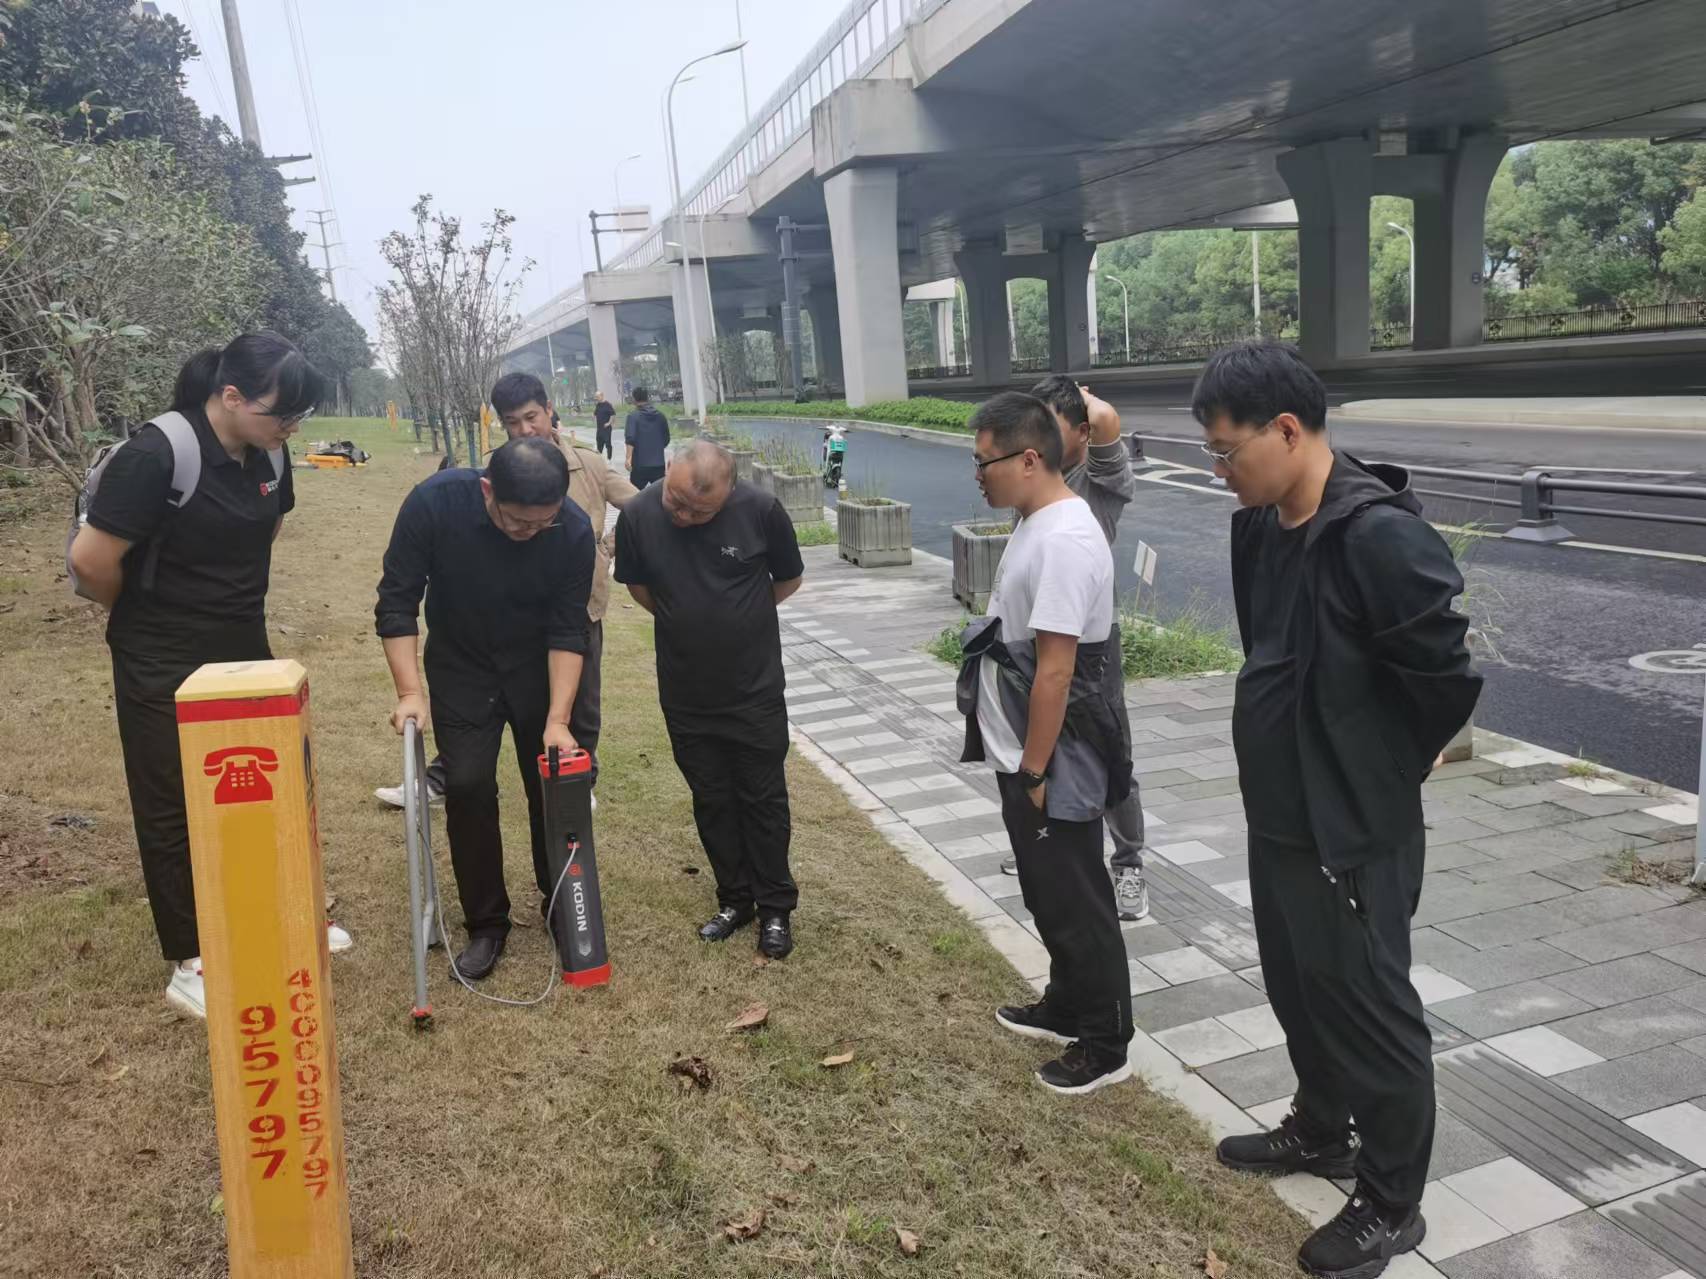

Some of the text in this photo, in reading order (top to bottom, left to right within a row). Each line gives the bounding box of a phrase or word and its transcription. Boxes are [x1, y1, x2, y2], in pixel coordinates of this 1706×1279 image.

[572, 881, 588, 932] KODIN
[239, 1004, 288, 1181] 95797
[287, 968, 330, 1200] 4000095797
